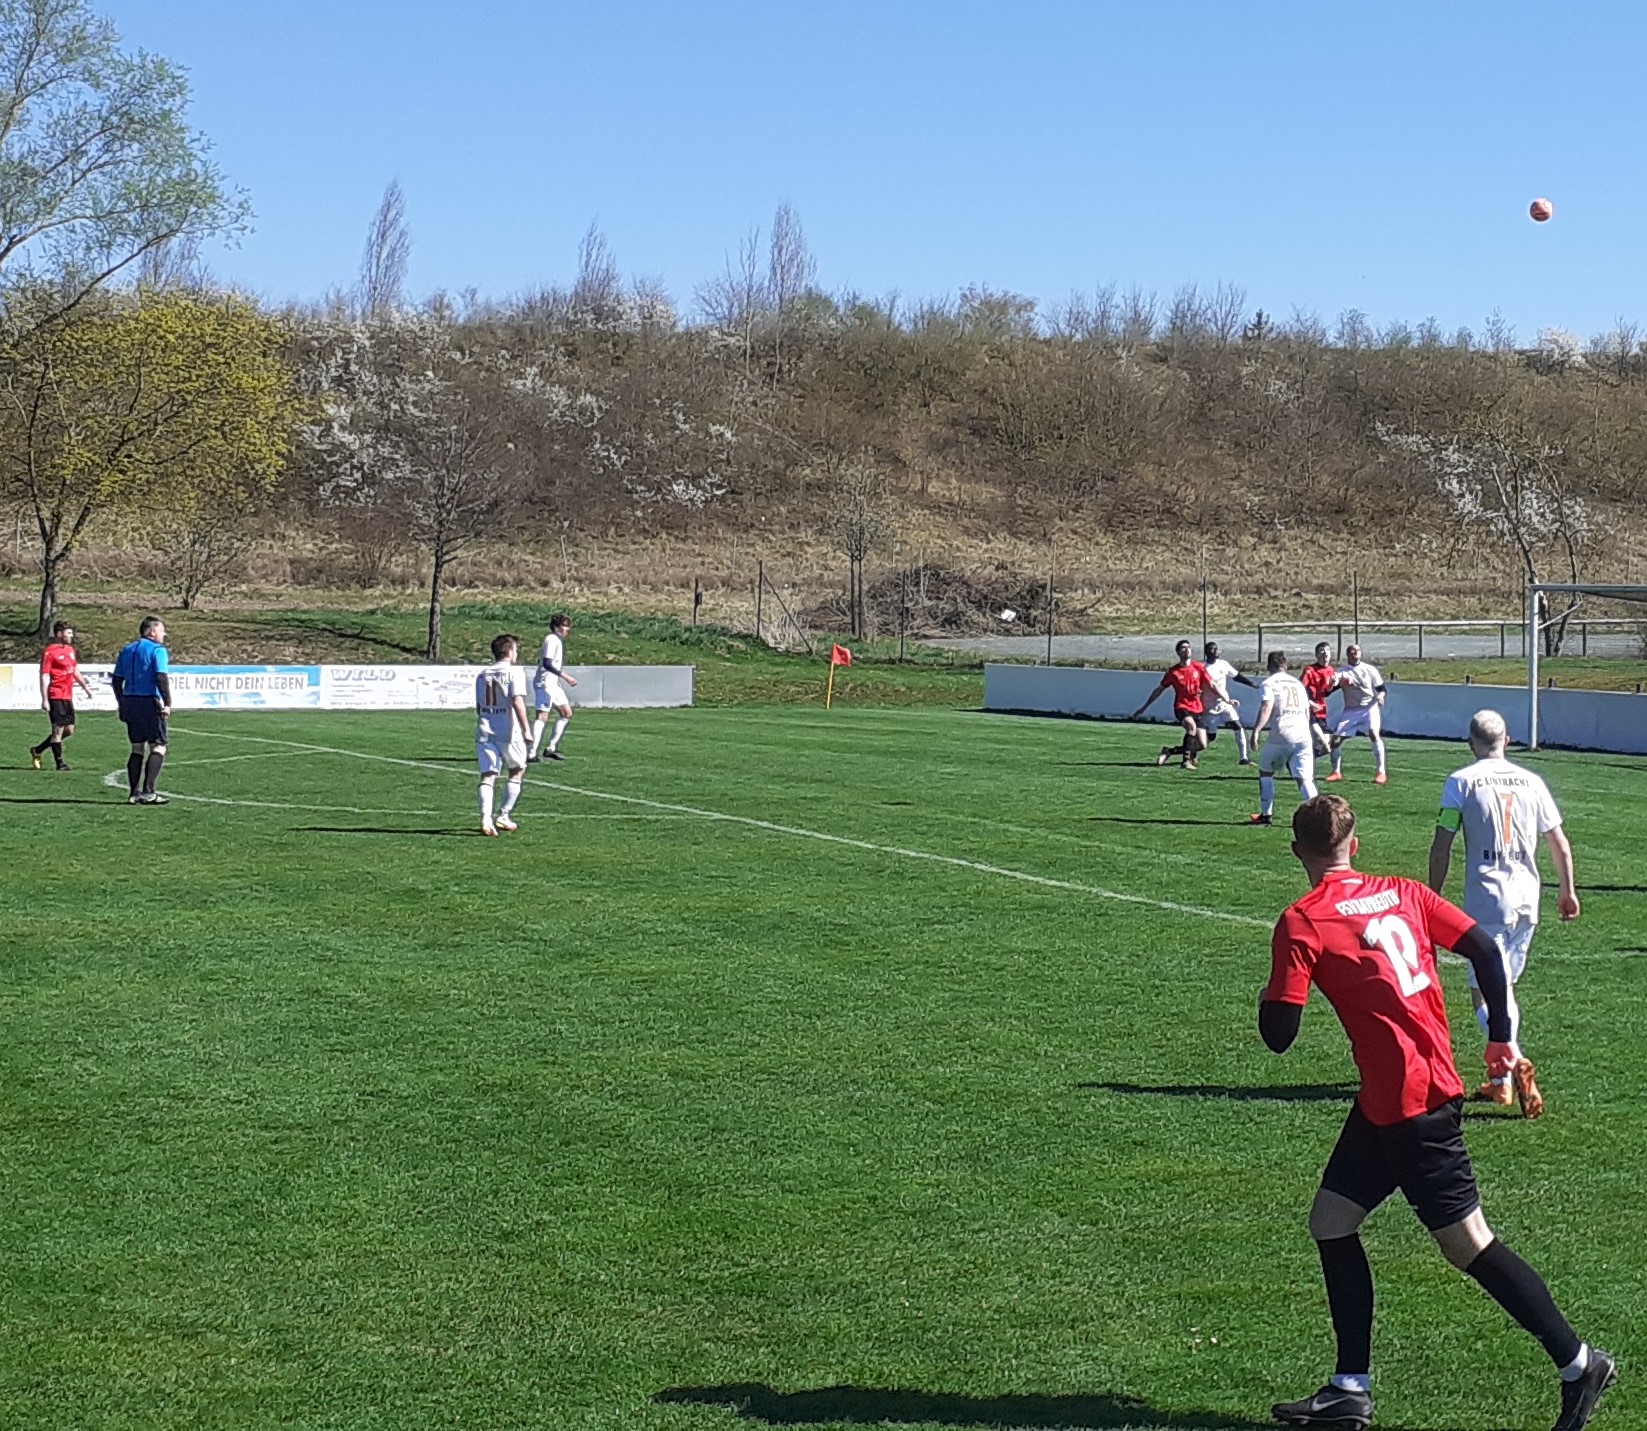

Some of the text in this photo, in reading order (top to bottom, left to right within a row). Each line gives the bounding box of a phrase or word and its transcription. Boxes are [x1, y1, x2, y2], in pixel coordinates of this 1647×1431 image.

[194, 676, 232, 690] NICHT
[235, 676, 264, 690] DEIN
[267, 676, 304, 690] LEBEN
[331, 669, 396, 681] WILD
[1282, 686, 1300, 708] 28
[1499, 792, 1514, 845] 7
[1362, 914, 1432, 998] 12
